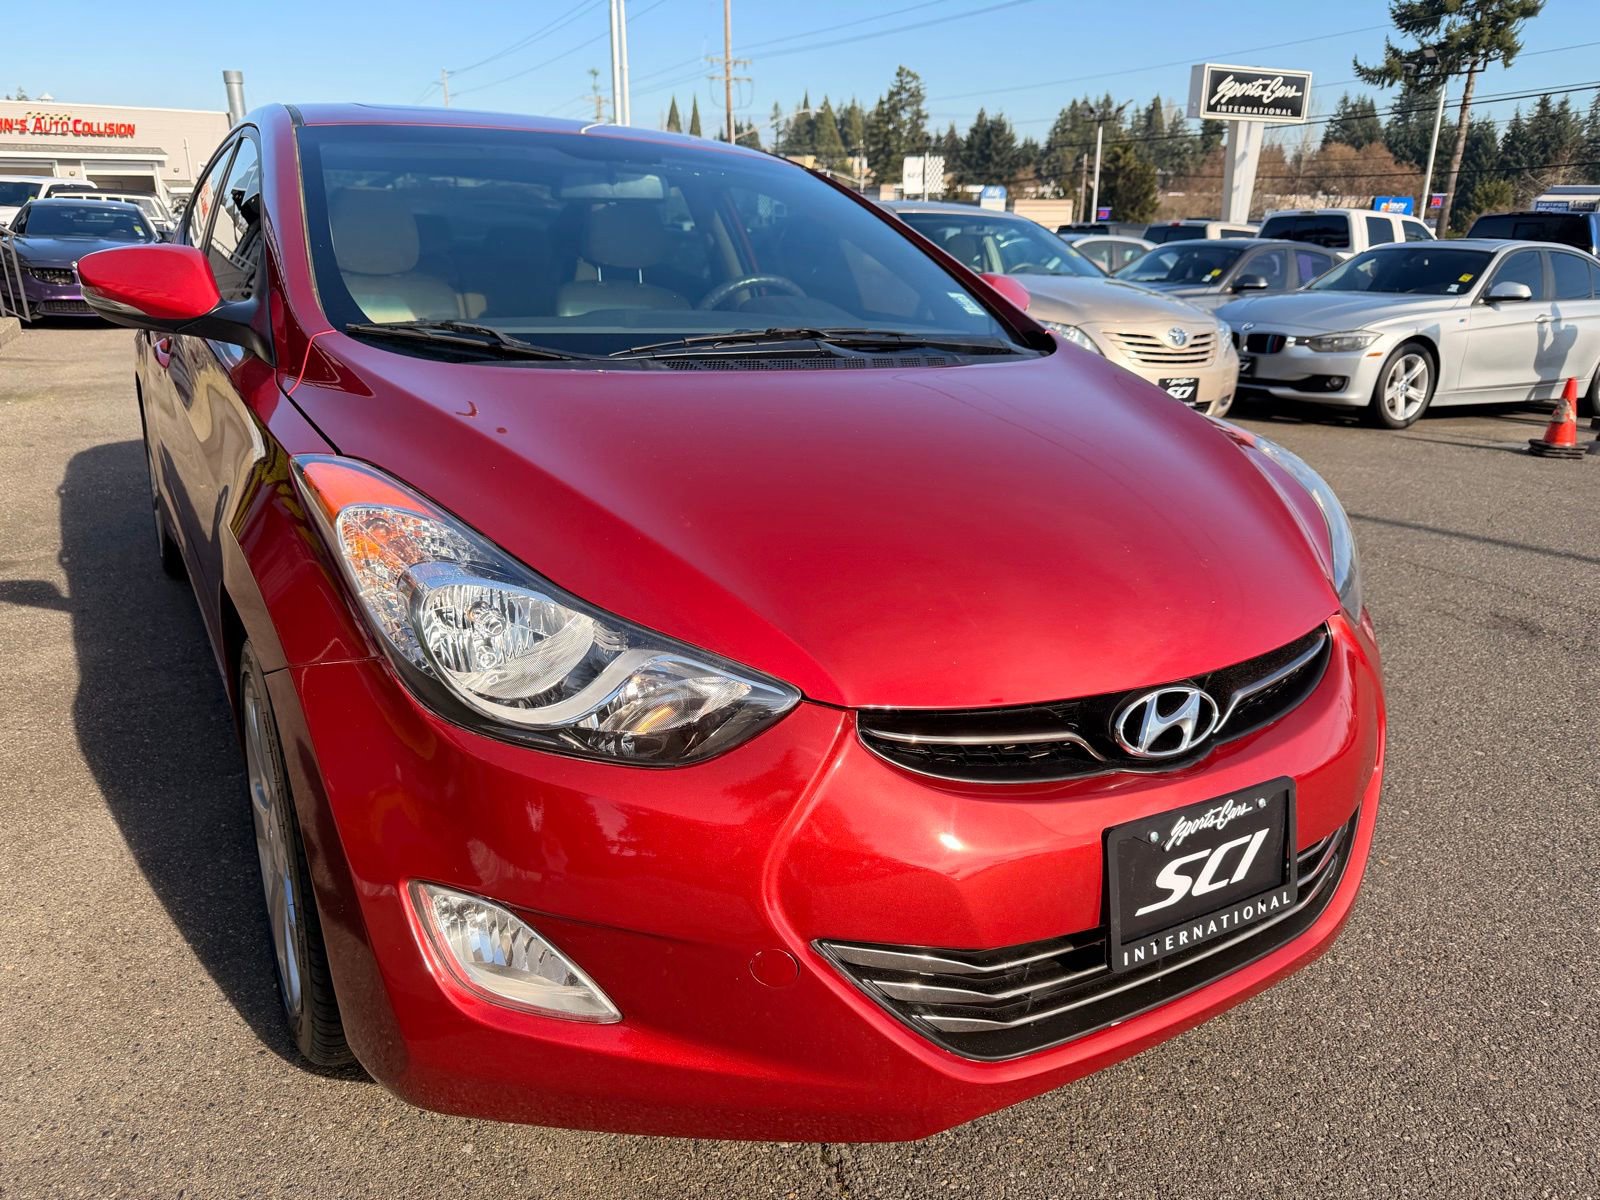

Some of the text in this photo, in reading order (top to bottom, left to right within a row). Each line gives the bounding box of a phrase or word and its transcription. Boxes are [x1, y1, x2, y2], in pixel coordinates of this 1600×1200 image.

[1210, 74, 1302, 105] Sports Cars
[1216, 104, 1292, 116] INTERNATIONAL
[0, 118, 27, 132] N'S
[1164, 799, 1252, 851] Sports Cars
[1134, 828, 1270, 917] SCI
[1123, 892, 1290, 966] INTERNATIONAL
